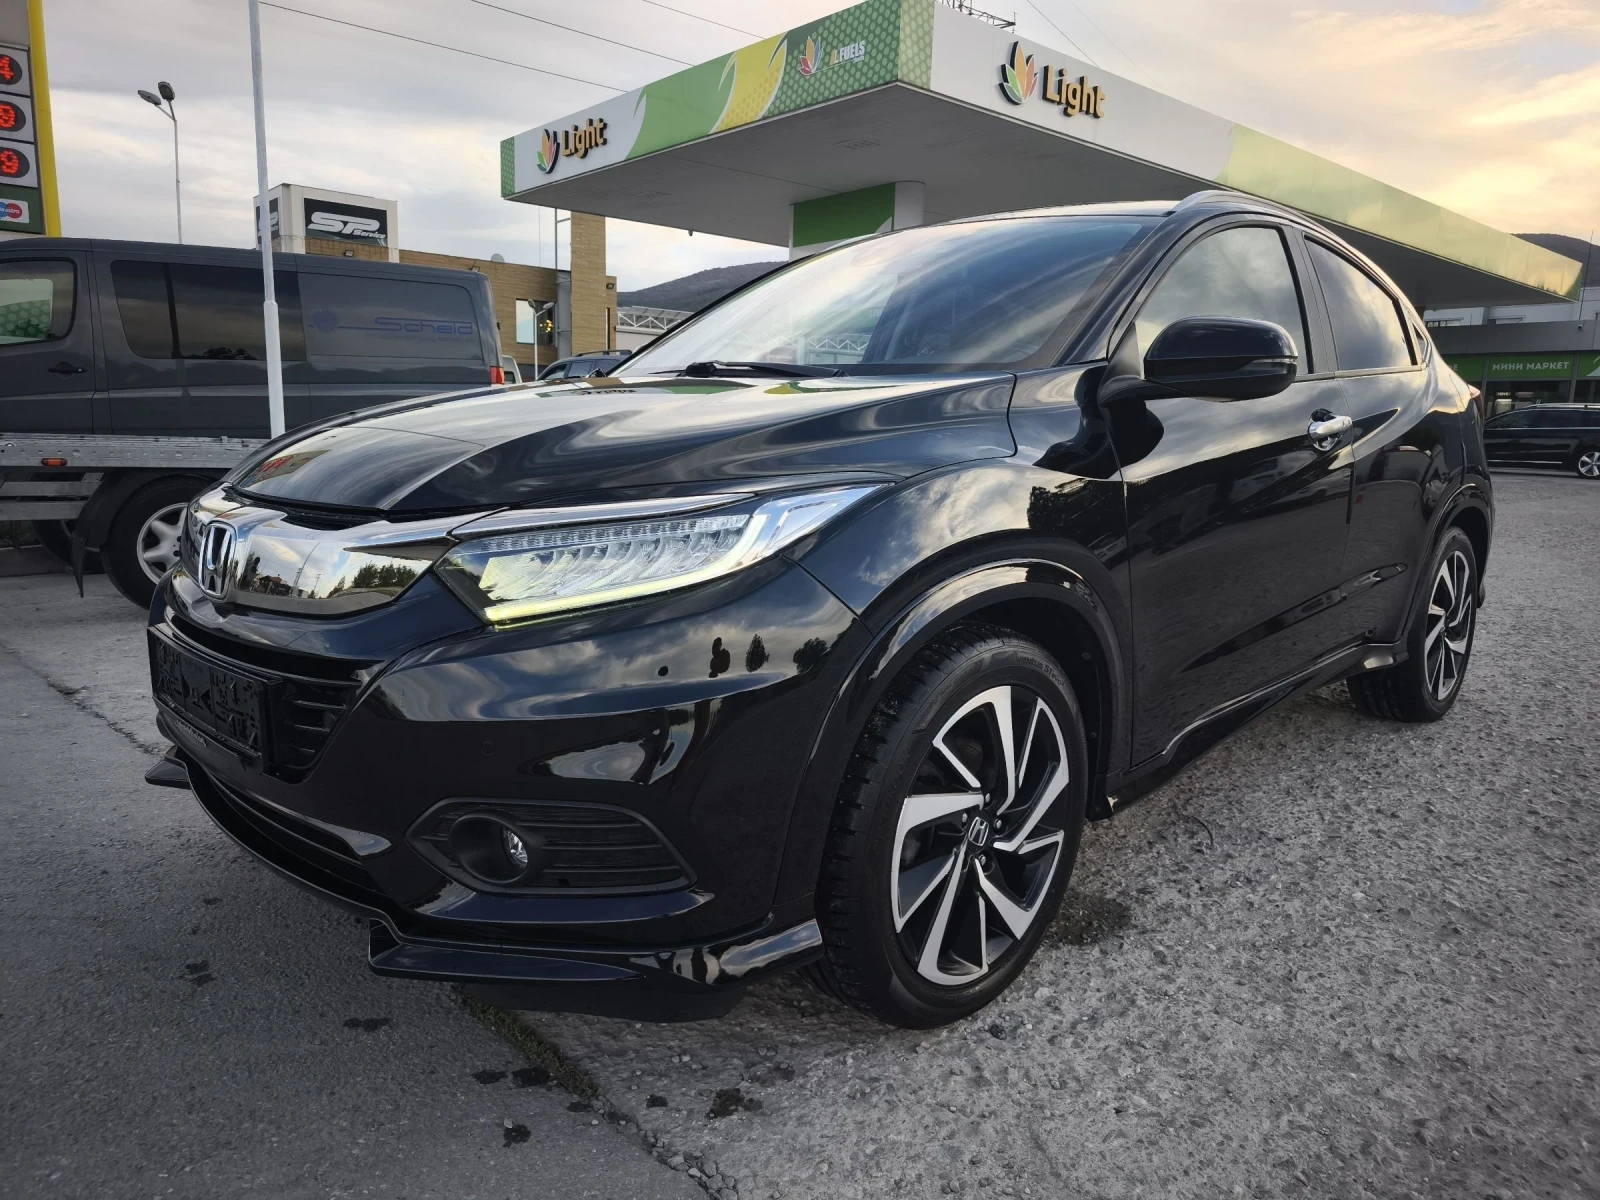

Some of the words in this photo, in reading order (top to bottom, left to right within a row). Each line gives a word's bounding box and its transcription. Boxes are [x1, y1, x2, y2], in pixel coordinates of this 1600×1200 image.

[1042, 65, 1106, 118] Light
[562, 118, 607, 159] Light
[307, 211, 380, 234] SP
[353, 229, 386, 239] Service
[374, 316, 473, 335] Scheid
[1492, 363, 1523, 371] МИНИ
[1526, 361, 1570, 370] МАРКЕТ
